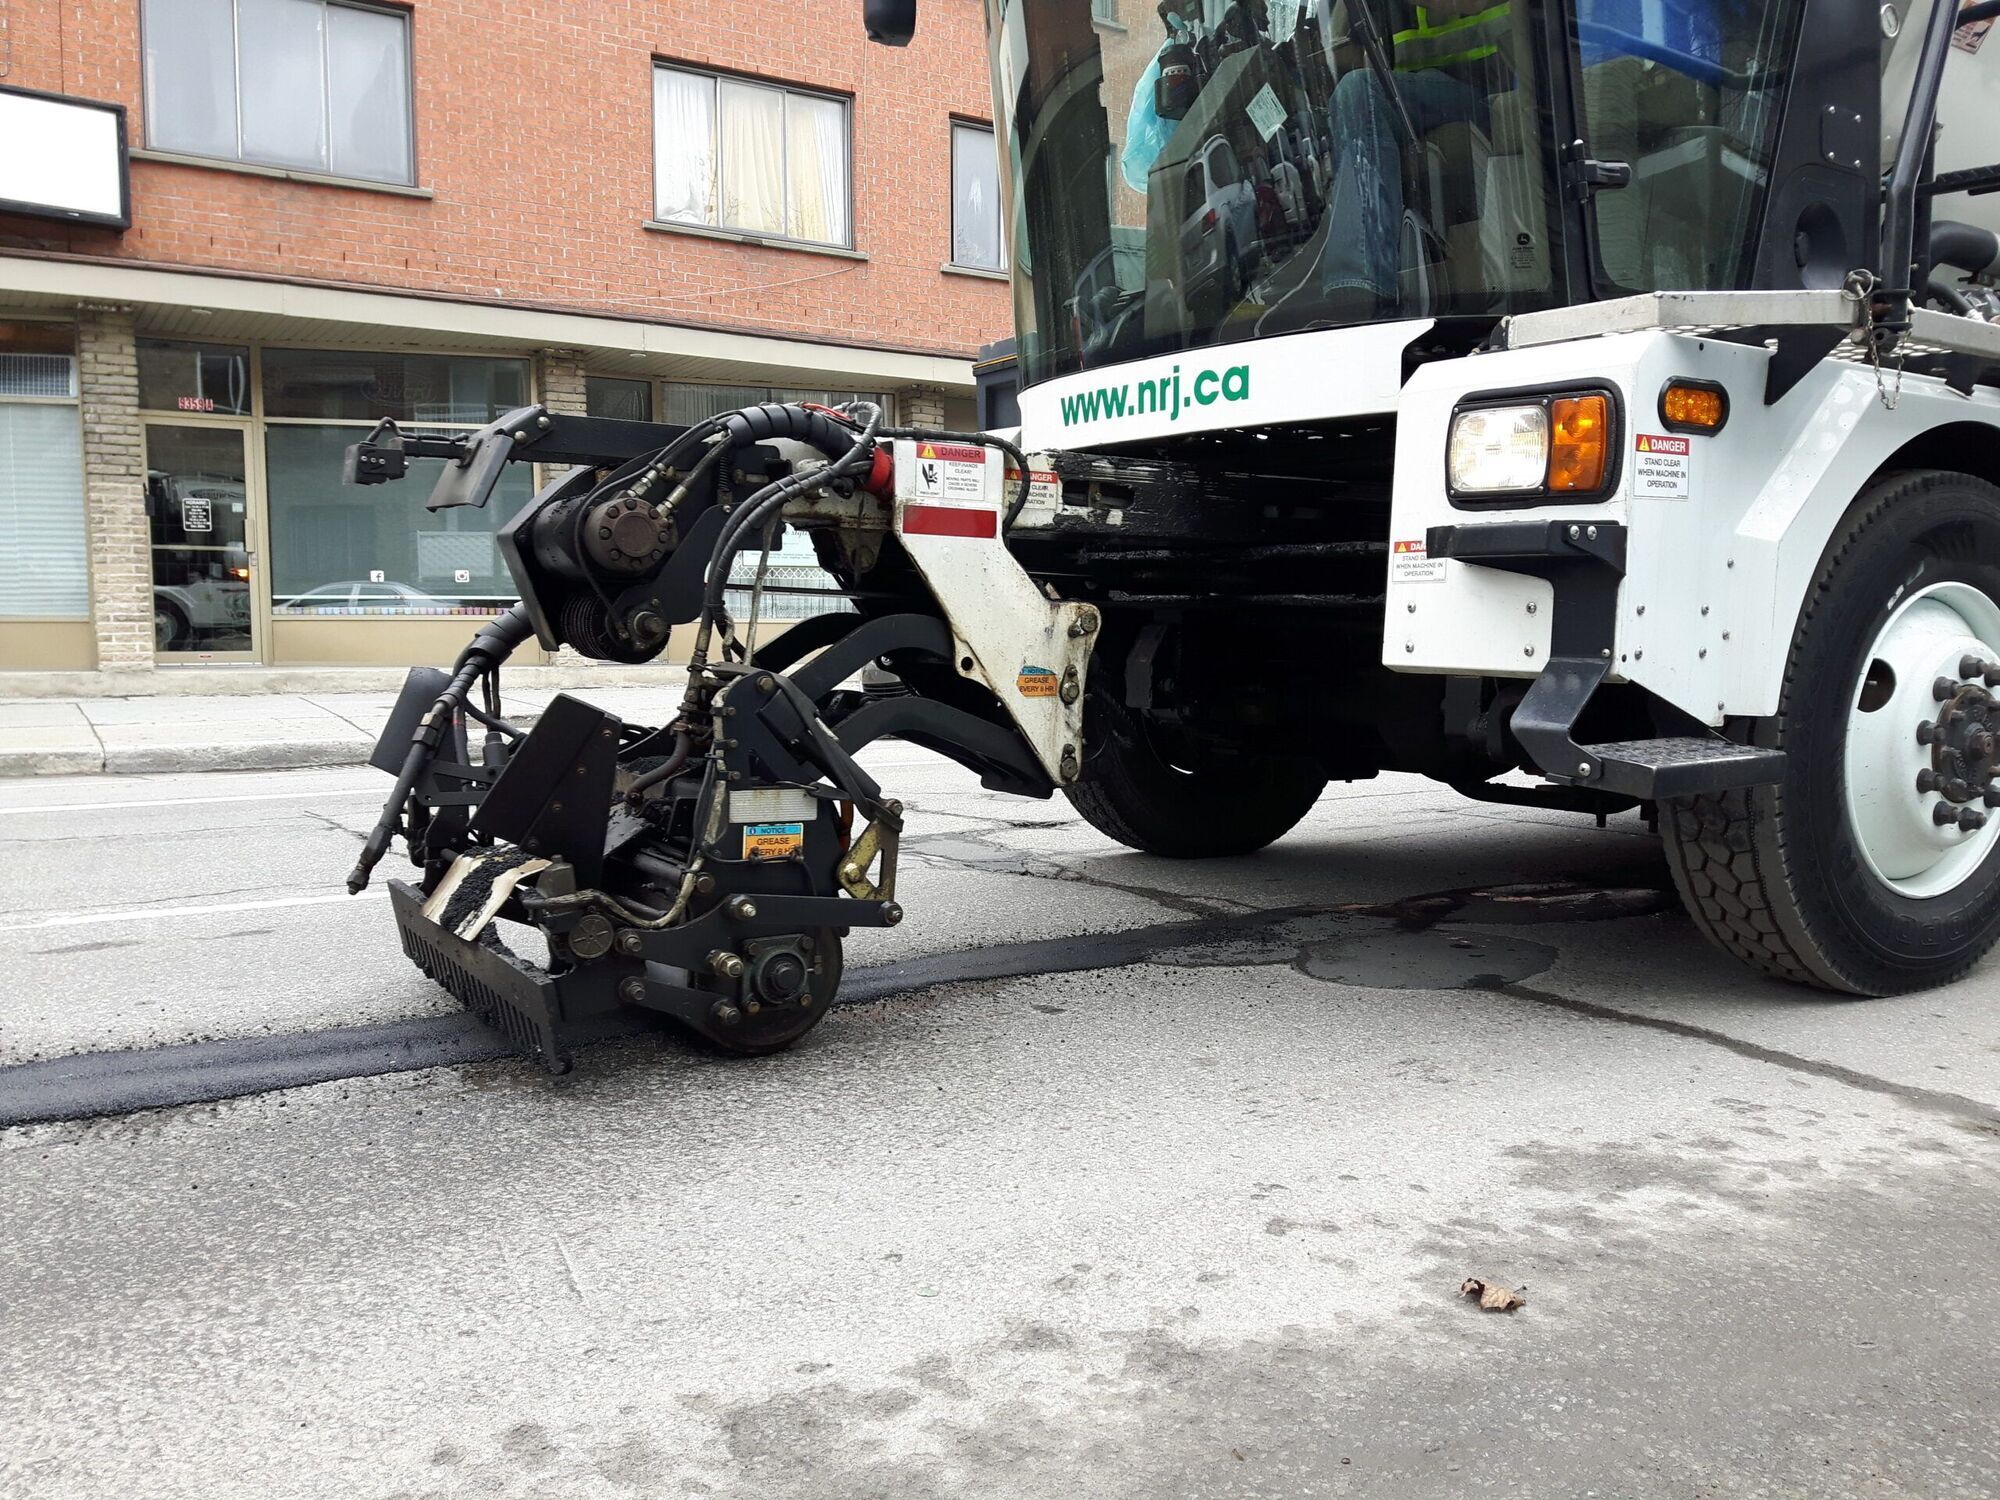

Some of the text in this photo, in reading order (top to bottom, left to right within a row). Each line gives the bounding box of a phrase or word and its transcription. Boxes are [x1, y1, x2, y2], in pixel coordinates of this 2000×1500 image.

[1060, 365, 1249, 427] www.nrj.ca
[1651, 438, 1686, 452] DANGER
[940, 446, 981, 459] DANGER
[1644, 457, 1681, 467] STAND CLEAR
[1637, 468, 1655, 476] WHEN
[1656, 469, 1680, 478] MACHINE
[1647, 480, 1677, 488] OPERATION
[757, 837, 790, 845] GREASE
